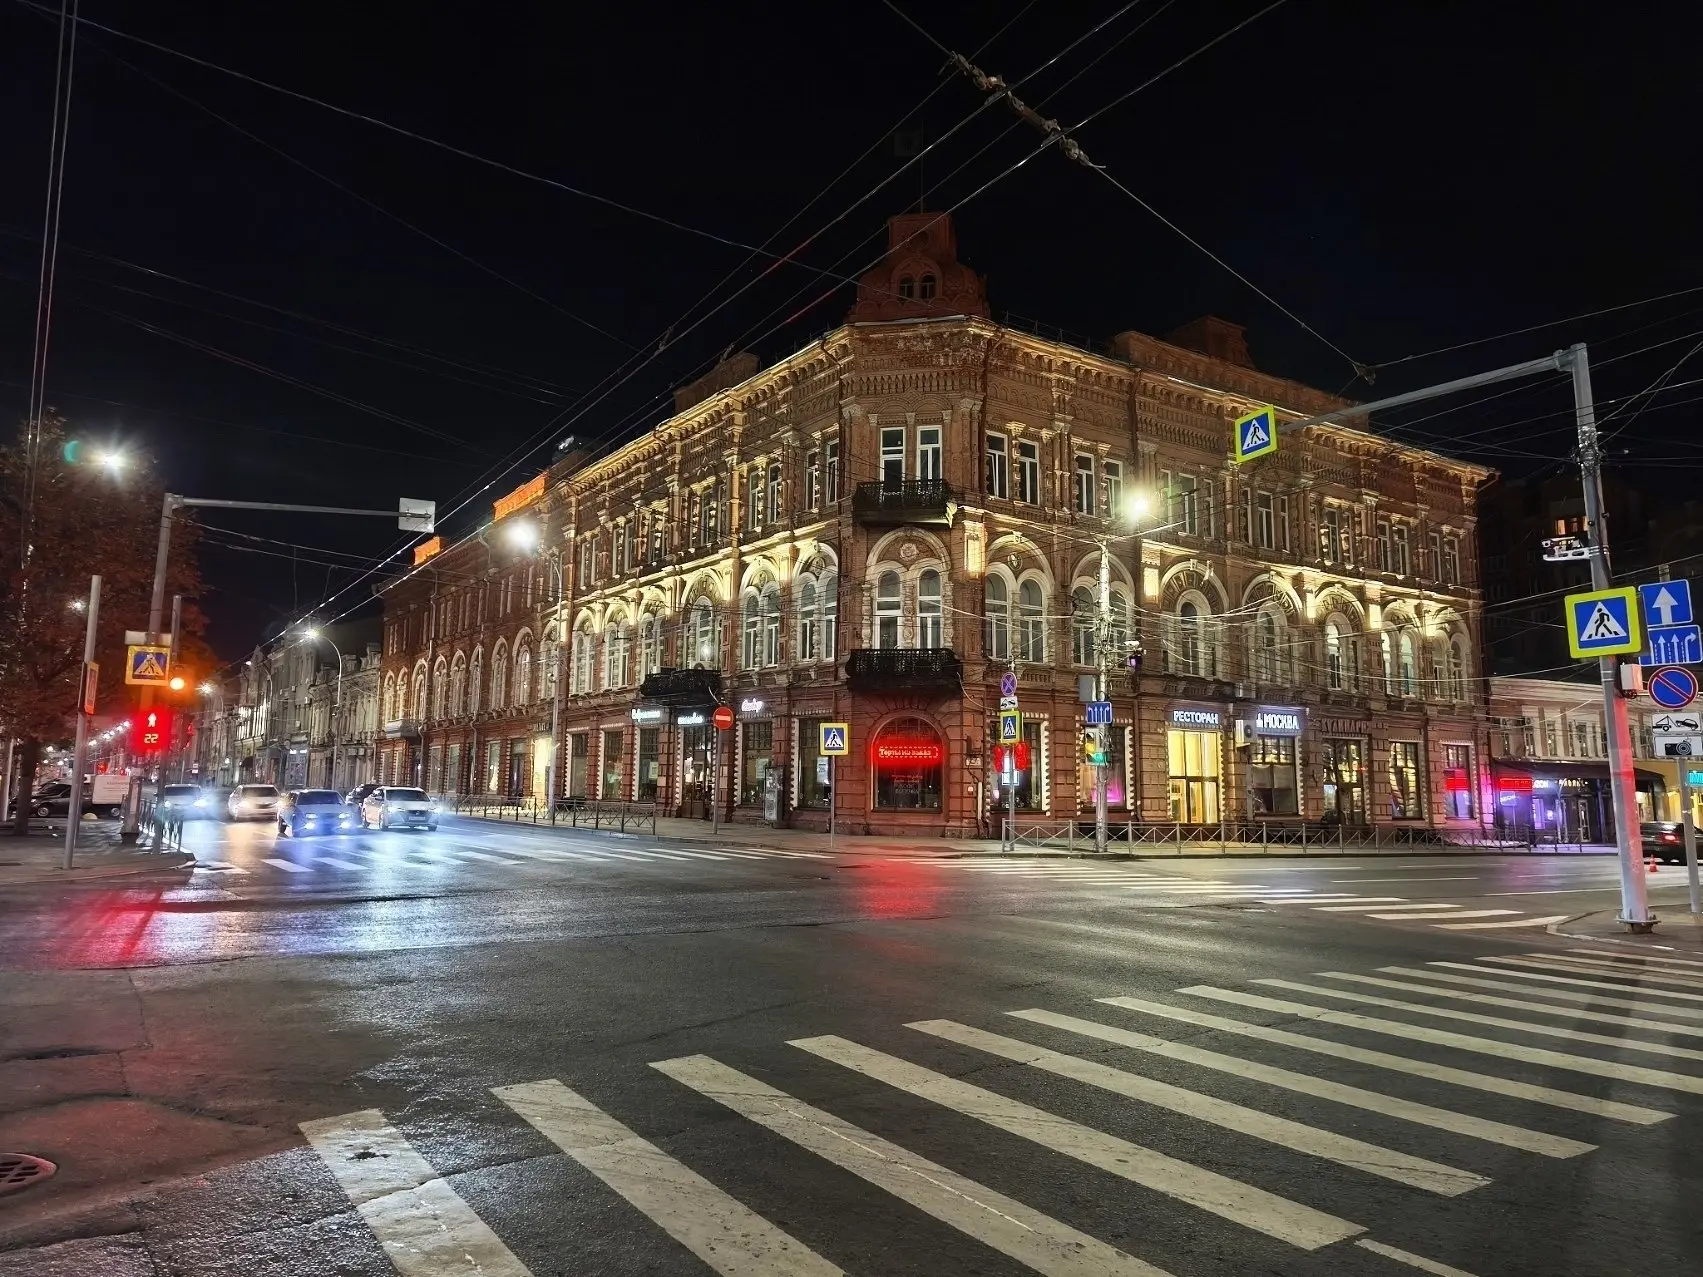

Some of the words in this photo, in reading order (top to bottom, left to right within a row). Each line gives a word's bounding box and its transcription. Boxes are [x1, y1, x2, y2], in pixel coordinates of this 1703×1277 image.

[1173, 710, 1219, 725] РЕСТОРАН
[1263, 713, 1300, 729] МОСКВА
[144, 733, 159, 744] 22
